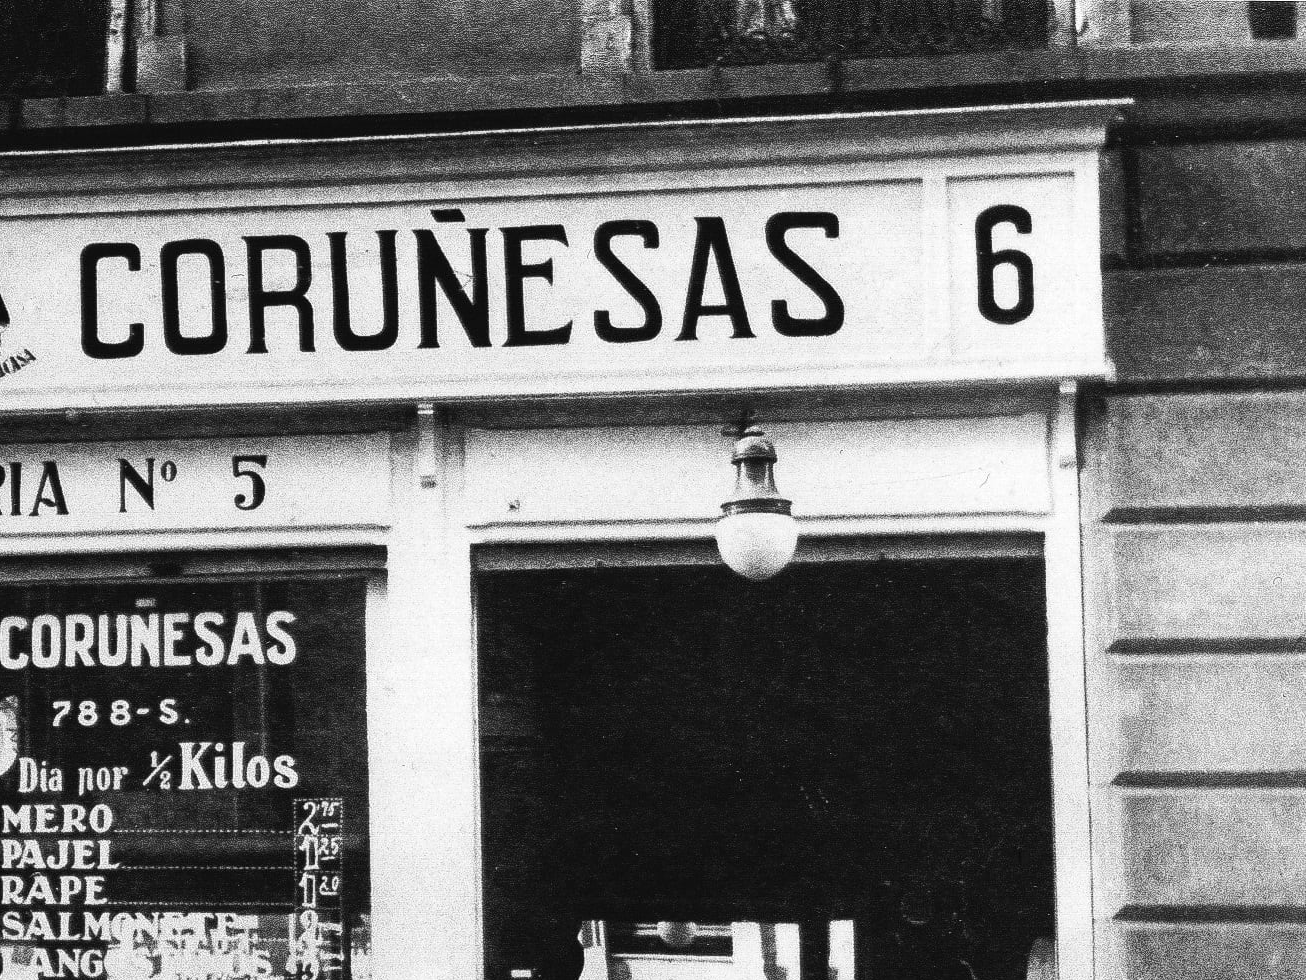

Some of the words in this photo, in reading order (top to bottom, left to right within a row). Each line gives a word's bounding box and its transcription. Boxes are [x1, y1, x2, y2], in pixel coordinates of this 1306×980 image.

[79, 208, 846, 360] CORUÑESAS
[975, 203, 1035, 325] 6
[231, 454, 269, 511] 5
[0, 599, 298, 669] CORUÑESAS
[18, 757, 64, 793] Dia
[78, 766, 129, 796] por
[178, 741, 299, 790] Kilos
[1, 804, 113, 833] MERO
[1, 839, 119, 869] PAJEL
[0, 875, 109, 905] RAPE
